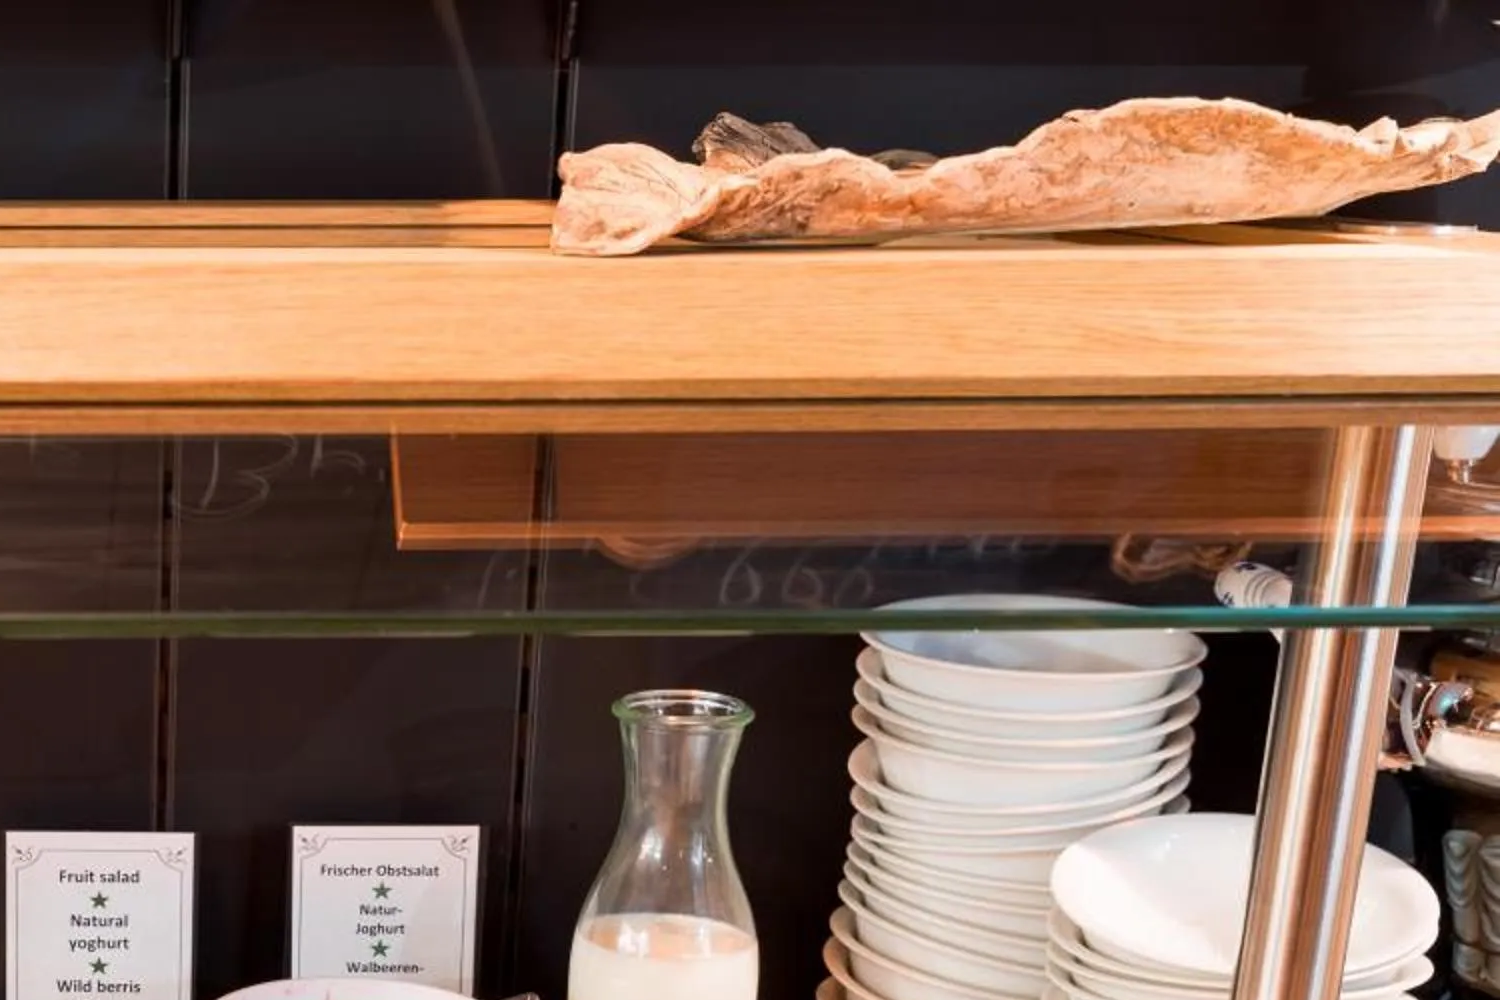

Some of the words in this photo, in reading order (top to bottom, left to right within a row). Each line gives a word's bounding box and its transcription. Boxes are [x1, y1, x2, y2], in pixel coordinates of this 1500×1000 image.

[58, 869, 96, 884] Fruit
[99, 869, 141, 884] salad
[320, 864, 373, 877] Frischer
[375, 864, 441, 877] Obstsalat
[358, 904, 404, 916] Natur-
[70, 914, 129, 928] Natural
[355, 922, 406, 938] Joghurt
[68, 935, 130, 952] yoghurt
[56, 979, 92, 994] Wild
[96, 979, 142, 994] berris
